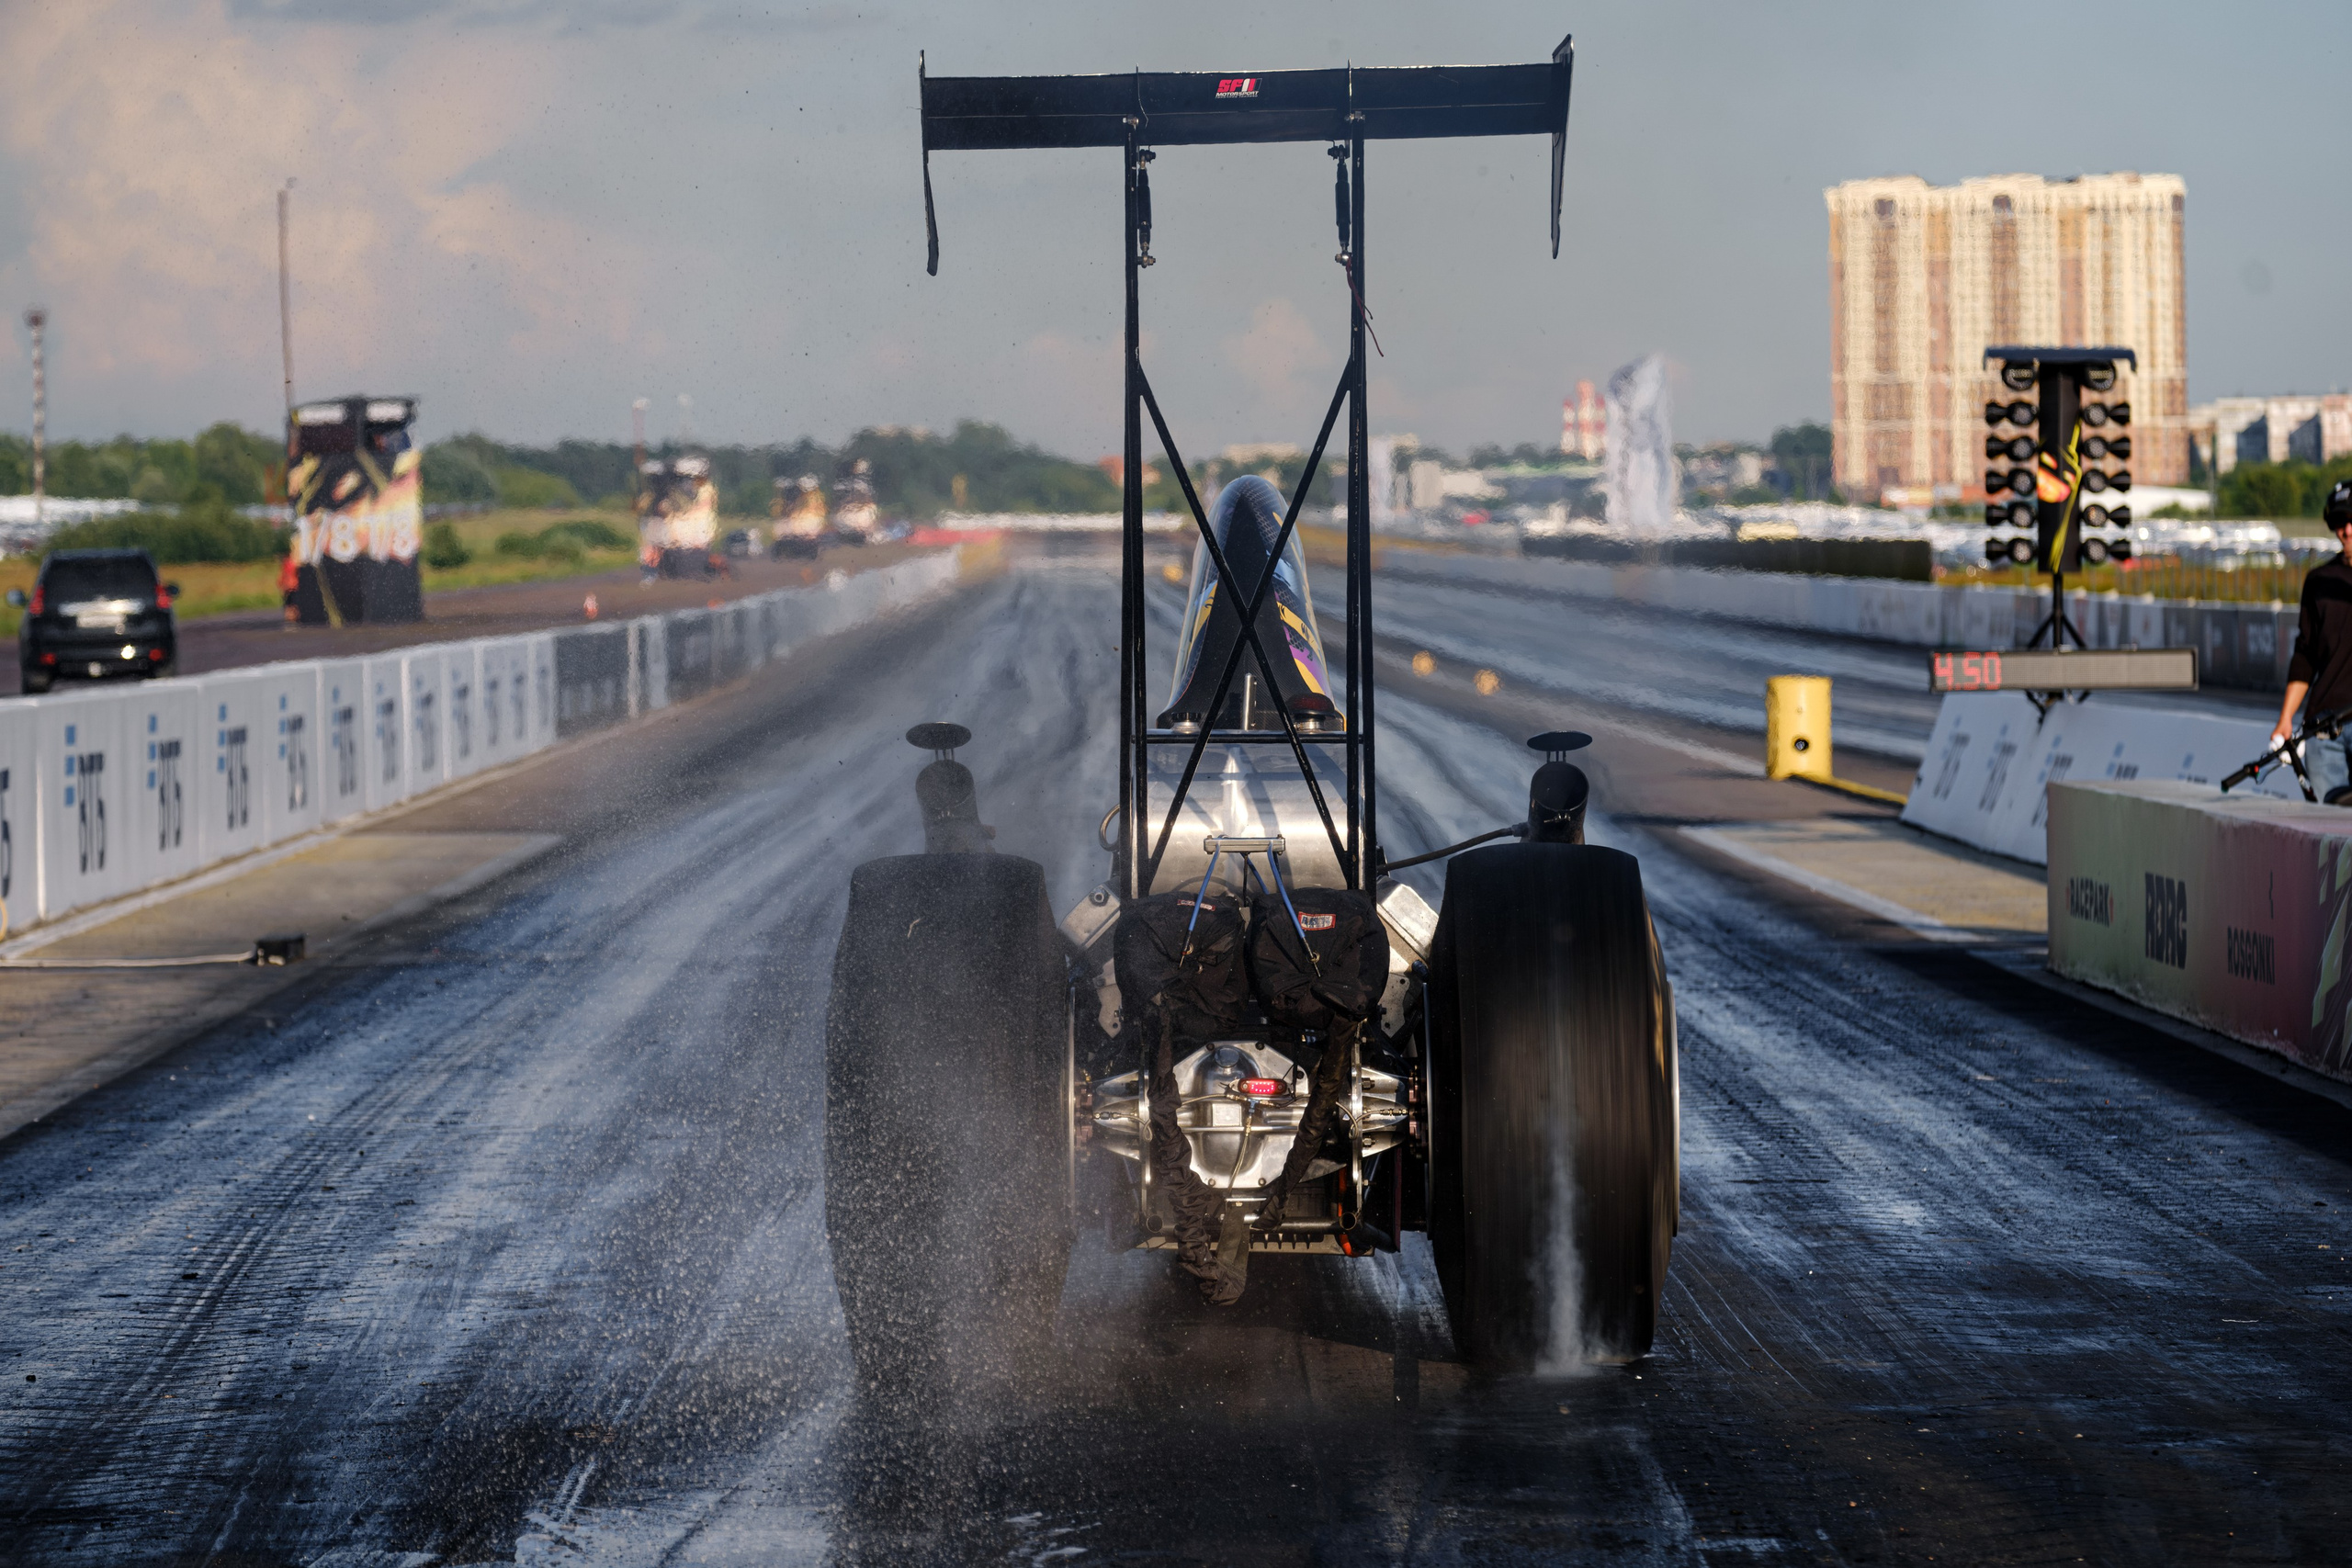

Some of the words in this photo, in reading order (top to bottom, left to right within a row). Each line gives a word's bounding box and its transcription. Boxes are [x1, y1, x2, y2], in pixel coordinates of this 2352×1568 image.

[1934, 652, 2001, 690] 4.50
[2069, 877, 2109, 928] RACEPARK
[2145, 871, 2187, 970] RDRC
[2227, 925, 2276, 986] ROSGONKI
